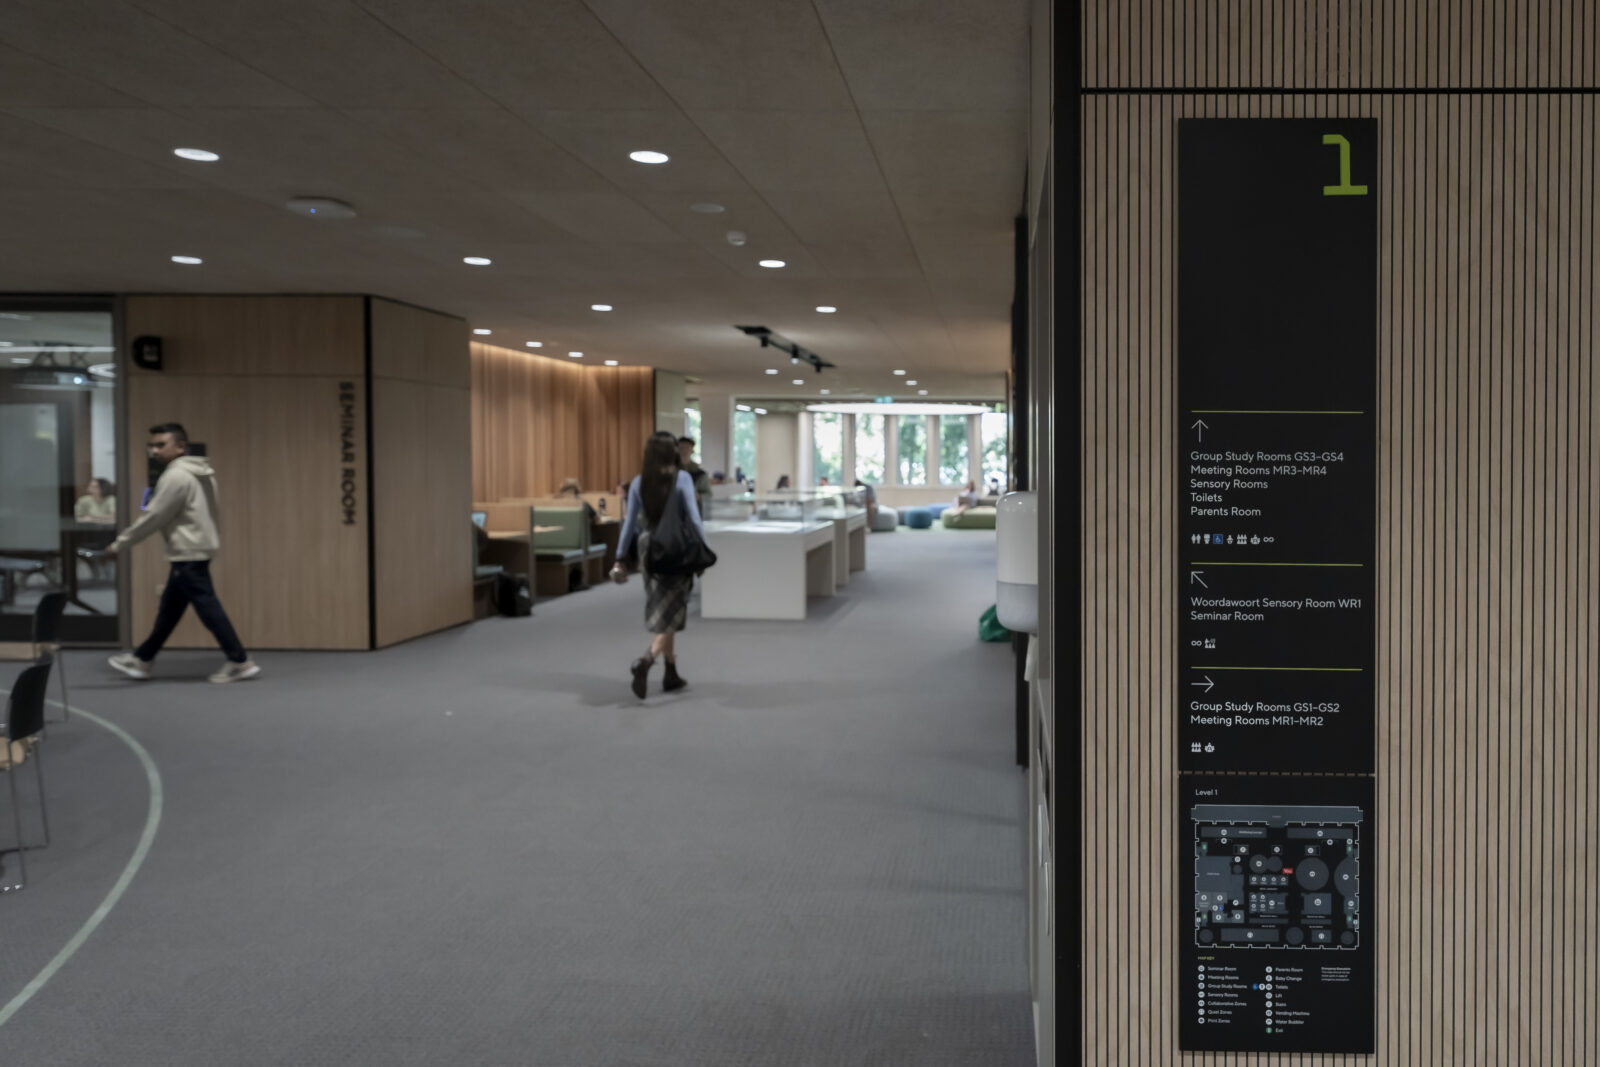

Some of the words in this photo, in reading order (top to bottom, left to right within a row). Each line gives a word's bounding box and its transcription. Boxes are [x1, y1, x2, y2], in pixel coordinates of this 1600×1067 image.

[1322, 134, 1368, 196] 1
[339, 382, 355, 463] SEMINAR
[1190, 451, 1223, 462] Group
[1225, 451, 1254, 463] Study
[1256, 452, 1292, 462] Rooms
[1190, 465, 1233, 476] Meeting
[1235, 466, 1271, 475] Rooms
[1190, 479, 1231, 490] Sensory
[1233, 479, 1269, 489] Rooms
[341, 467, 356, 526] ROOM
[1190, 492, 1223, 502] Toilets
[1190, 506, 1229, 516] Parents
[1231, 507, 1262, 516] Room
[1190, 597, 1261, 607] Woordawoort
[1262, 597, 1304, 610] Sensory
[1305, 598, 1336, 608] Room
[1337, 599, 1362, 608] WR1
[1190, 611, 1232, 621] Seminar
[1234, 612, 1265, 621] Room
[1190, 701, 1223, 712] Group
[1224, 702, 1254, 714] Study
[1256, 702, 1292, 712] Rooms
[1190, 715, 1232, 727] Meeting
[1234, 716, 1270, 726] Rooms
